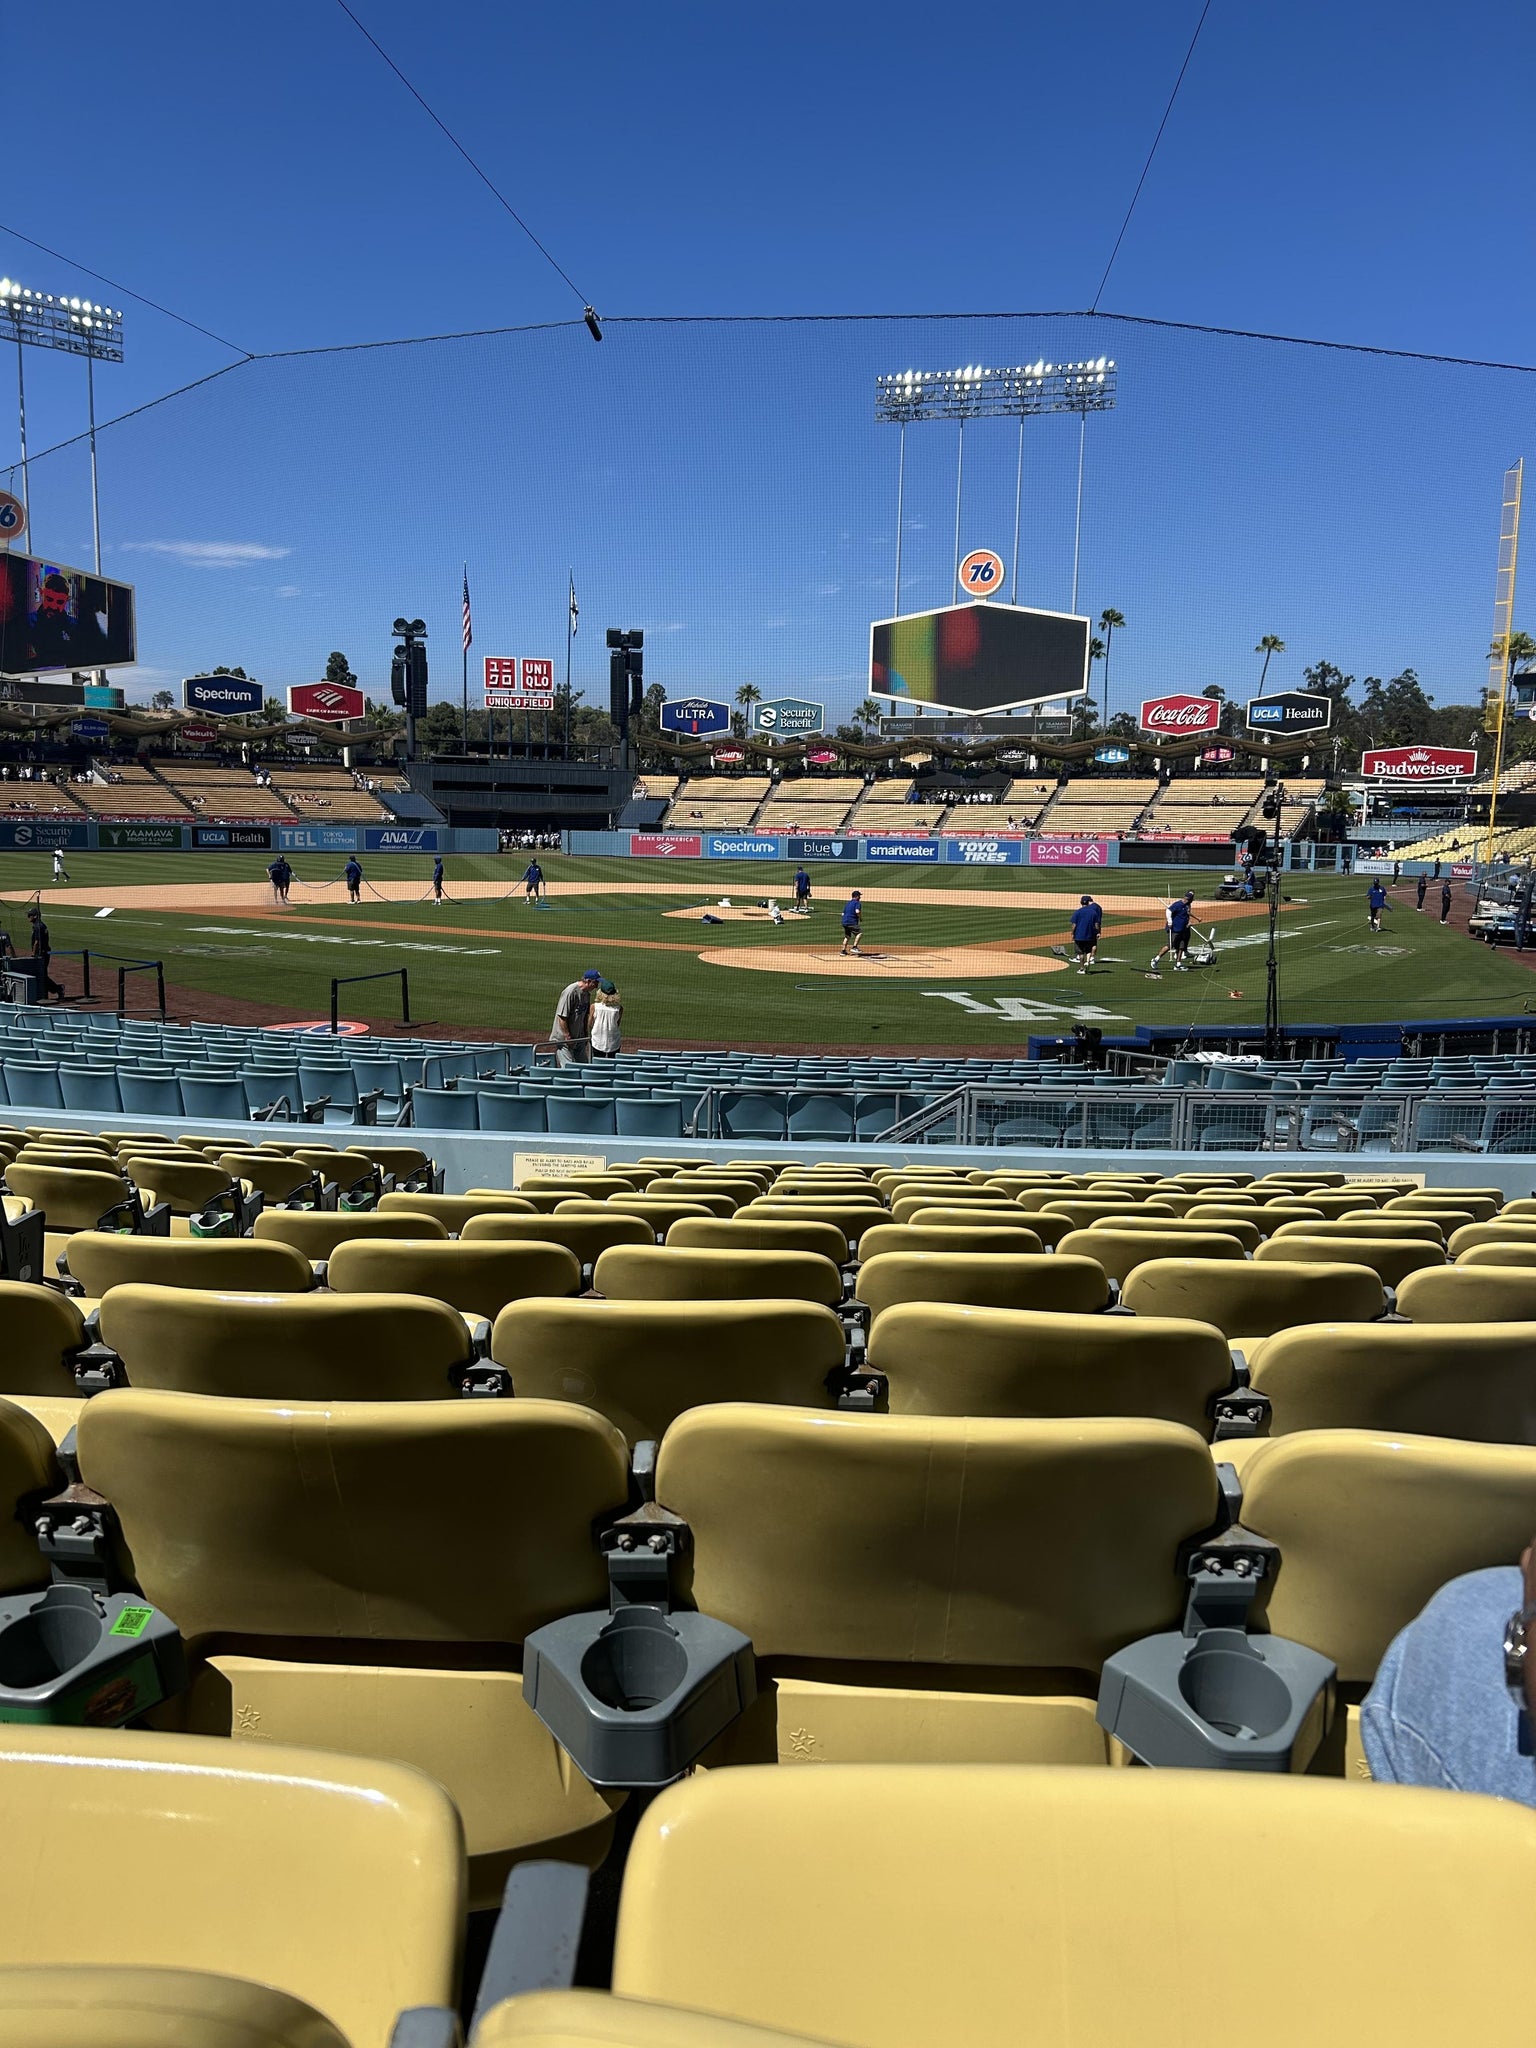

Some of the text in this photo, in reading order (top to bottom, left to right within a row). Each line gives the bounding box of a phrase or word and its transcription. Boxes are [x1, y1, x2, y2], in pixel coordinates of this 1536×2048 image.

[0, 504, 17, 528] 6
[969, 561, 995, 582] 76
[525, 663, 547, 675] UNI
[525, 675, 549, 688] QLO
[194, 686, 252, 701] Spectrum
[488, 697, 550, 708] UNIQLO FIELD
[675, 709, 715, 719] ULTRA
[780, 707, 818, 719] Security
[1147, 704, 1213, 726] Coca-Cola
[1253, 707, 1323, 719] UCLA Health
[780, 718, 812, 728] Benefit
[183, 729, 215, 738] Yakult
[1099, 747, 1126, 760] TEL
[1372, 760, 1465, 775] Budweiser
[35, 825, 73, 837] Security
[124, 828, 175, 838] YAAMAVA'
[36, 836, 69, 846] Benefit
[202, 832, 265, 843] UCLA Health
[281, 830, 317, 847] TEL
[323, 837, 355, 845] ELECTRON
[379, 831, 408, 844] ANA
[713, 840, 771, 854] Spectrum
[803, 841, 831, 853] blue
[870, 845, 935, 857] smartwater
[957, 841, 999, 853] TOYO
[1037, 845, 1083, 855] DAISO
[963, 852, 1008, 863] TIRES
[1452, 867, 1474, 875] Yakul
[920, 991, 1133, 1021] LA
